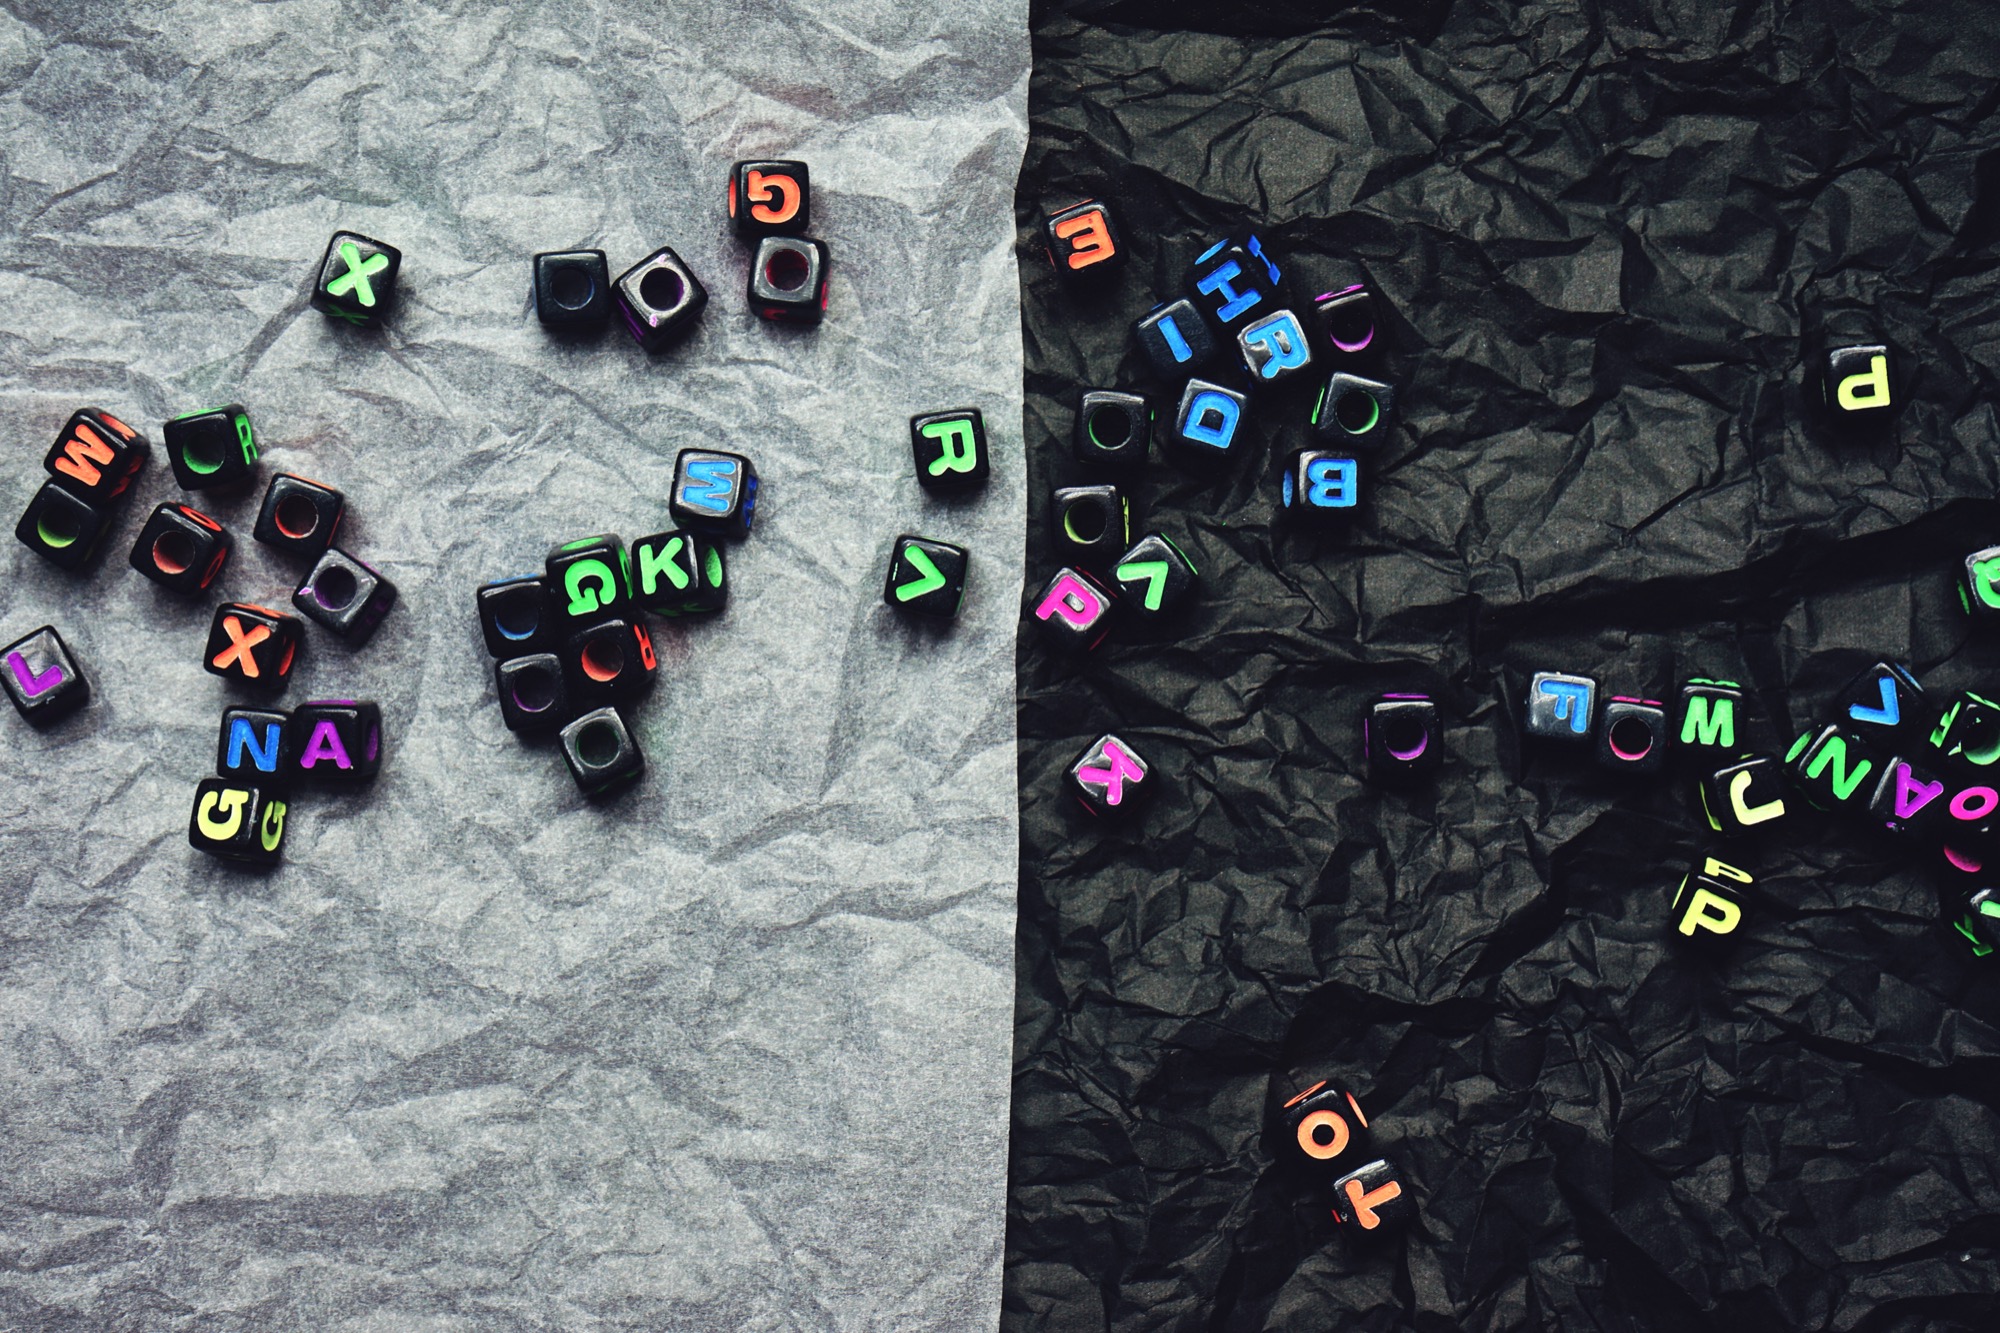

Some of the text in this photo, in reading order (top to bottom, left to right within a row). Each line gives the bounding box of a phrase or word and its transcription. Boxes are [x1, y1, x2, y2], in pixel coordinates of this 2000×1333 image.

[748, 171, 800, 224] G
[1056, 210, 1114, 269] E
[327, 243, 389, 307] X
[1196, 259, 1263, 323] H
[1246, 315, 1311, 379] R
[1837, 355, 1891, 411] P
[922, 419, 976, 474] R
[1183, 391, 1240, 449] D
[1308, 458, 1357, 508] B
[564, 559, 617, 616] G
[640, 537, 689, 594] K
[896, 545, 947, 600] V
[1117, 560, 1169, 610] V
[1035, 574, 1101, 625] P
[7, 651, 64, 697] L
[212, 615, 271, 678] X
[1538, 680, 1590, 734] F
[1849, 676, 1900, 726] V
[226, 717, 282, 773] N
[300, 719, 353, 770] A
[1078, 741, 1144, 806] K
[1894, 762, 1944, 819] A
[197, 789, 249, 841] G
[1678, 888, 1742, 936] P
[1297, 1109, 1350, 1159] O
